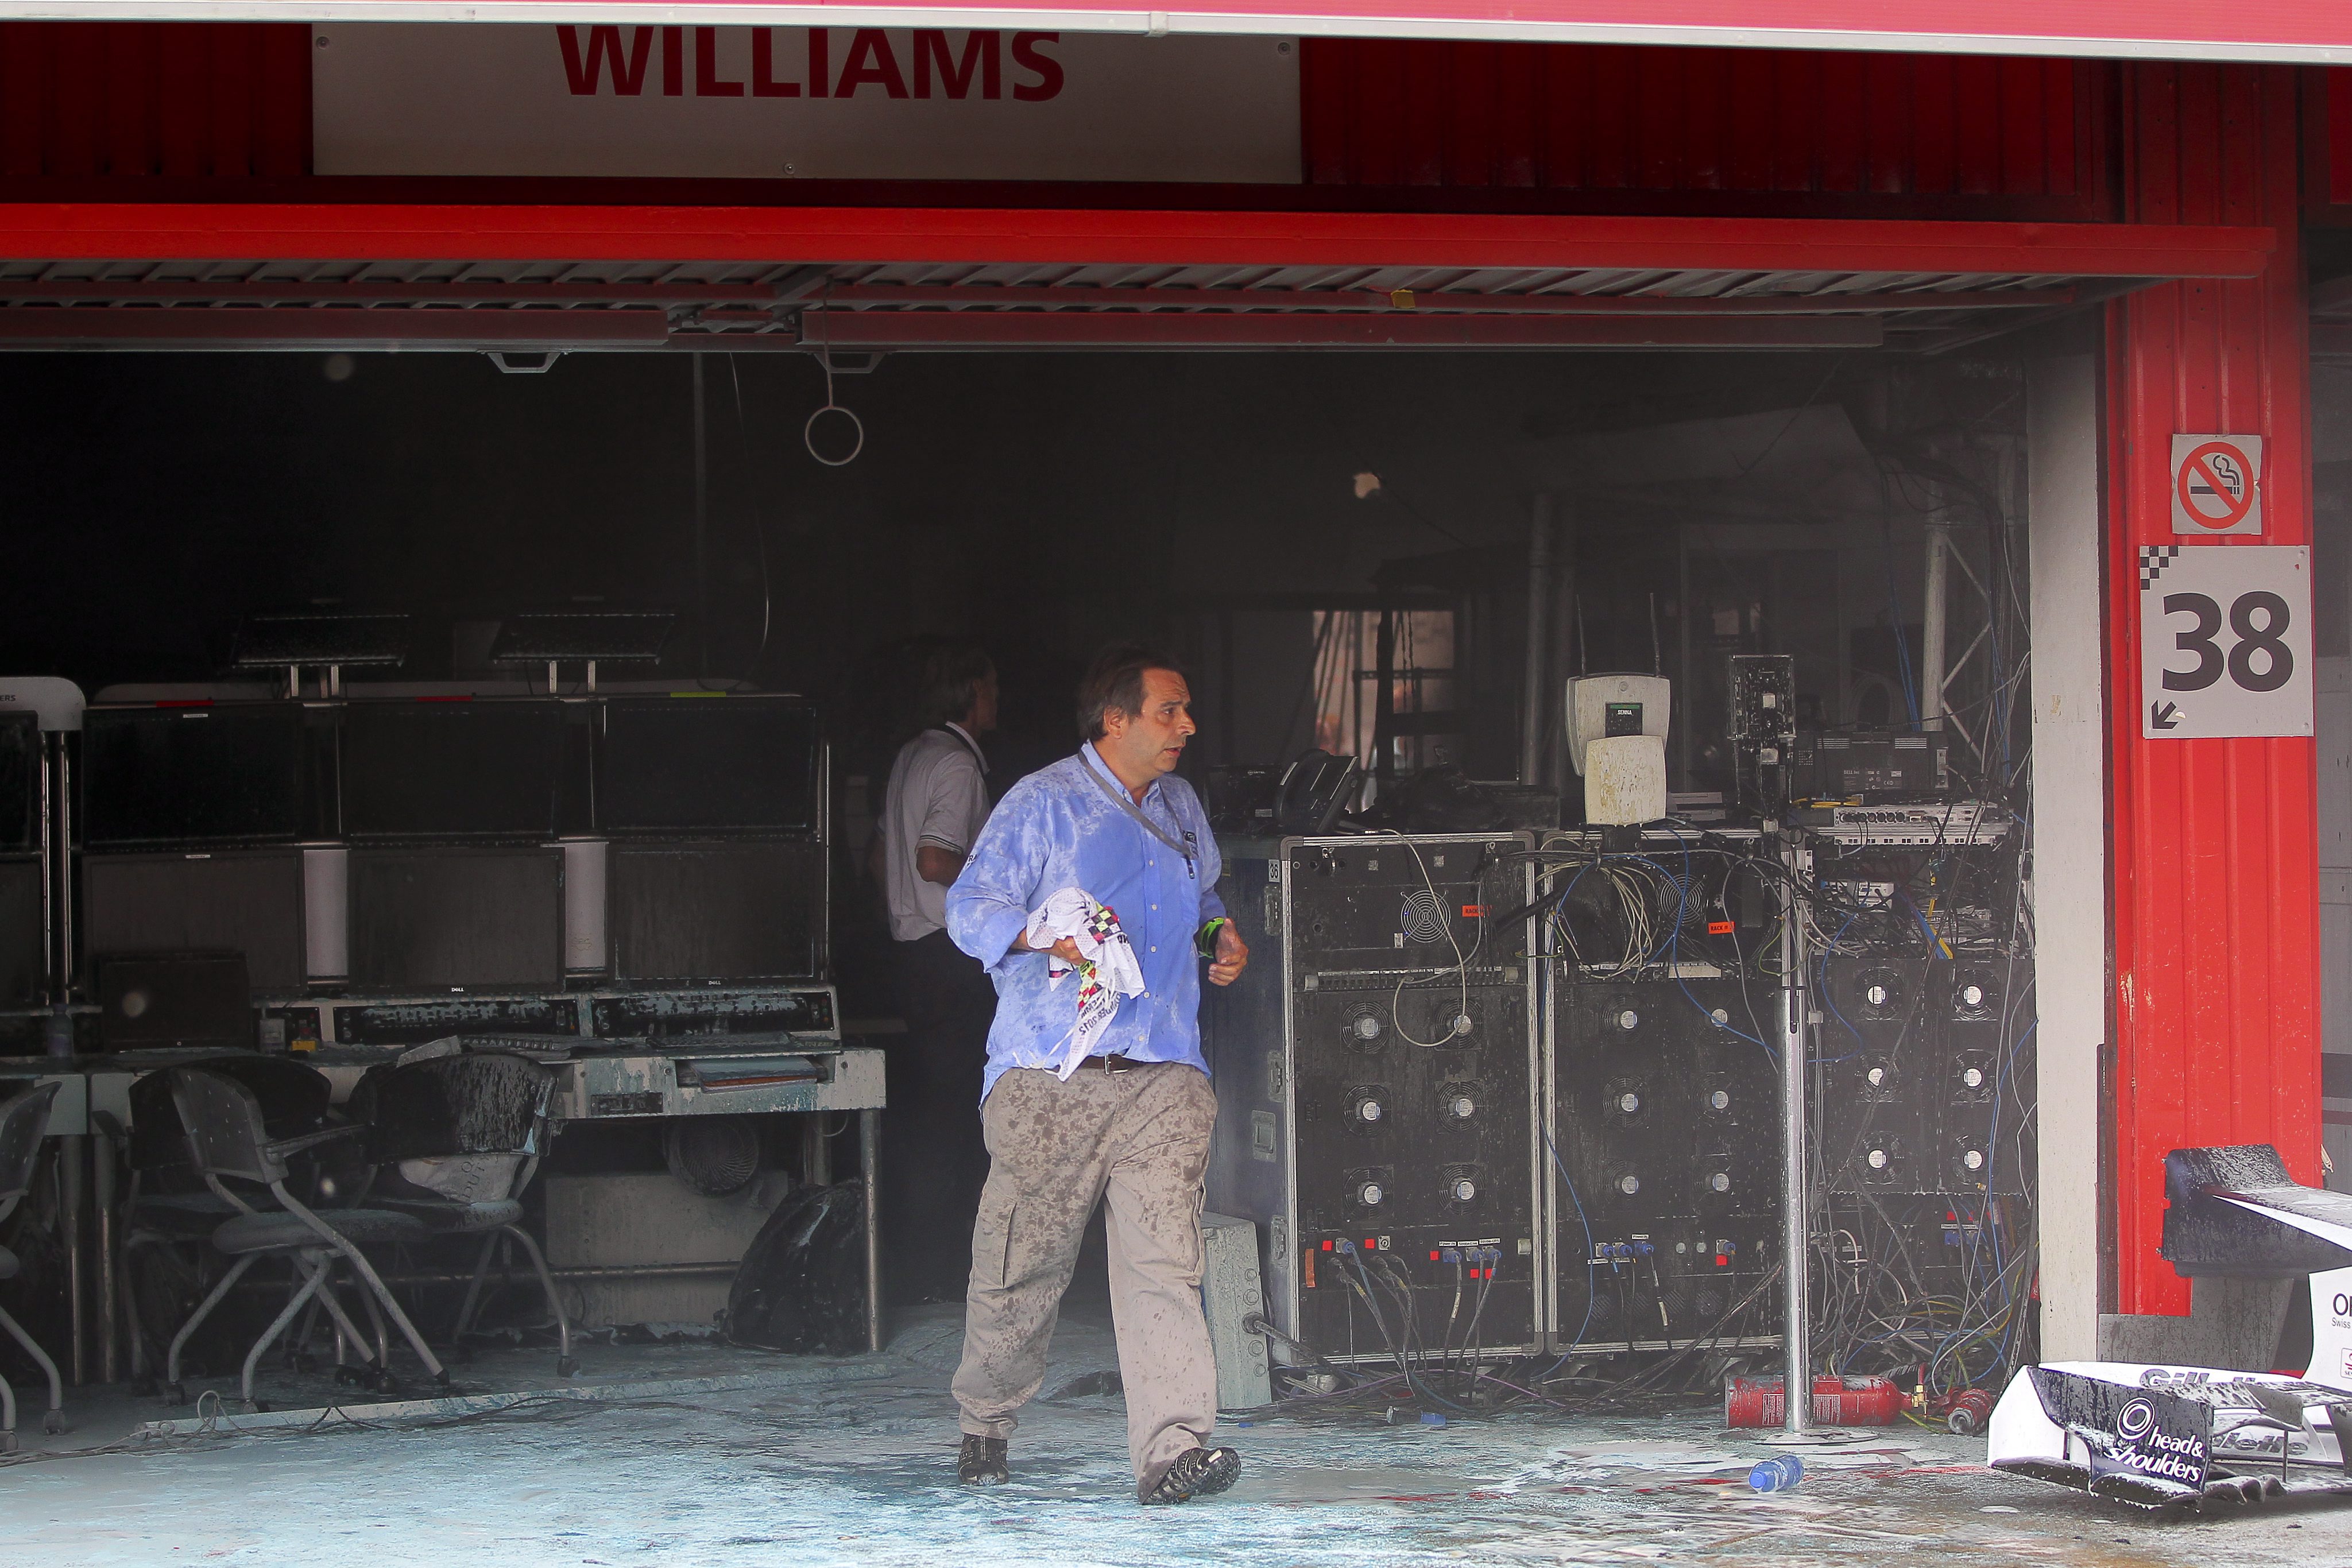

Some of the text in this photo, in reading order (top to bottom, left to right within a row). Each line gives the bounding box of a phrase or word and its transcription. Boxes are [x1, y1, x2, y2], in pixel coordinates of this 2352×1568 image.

[556, 25, 1065, 102] WILLIAMS
[2161, 591, 2294, 692] 38
[1270, 864, 1278, 878] 36
[2331, 1317, 2351, 1329] Swiss
[2148, 1425, 2203, 1458] head&
[2103, 1445, 2202, 1482] shoulders
